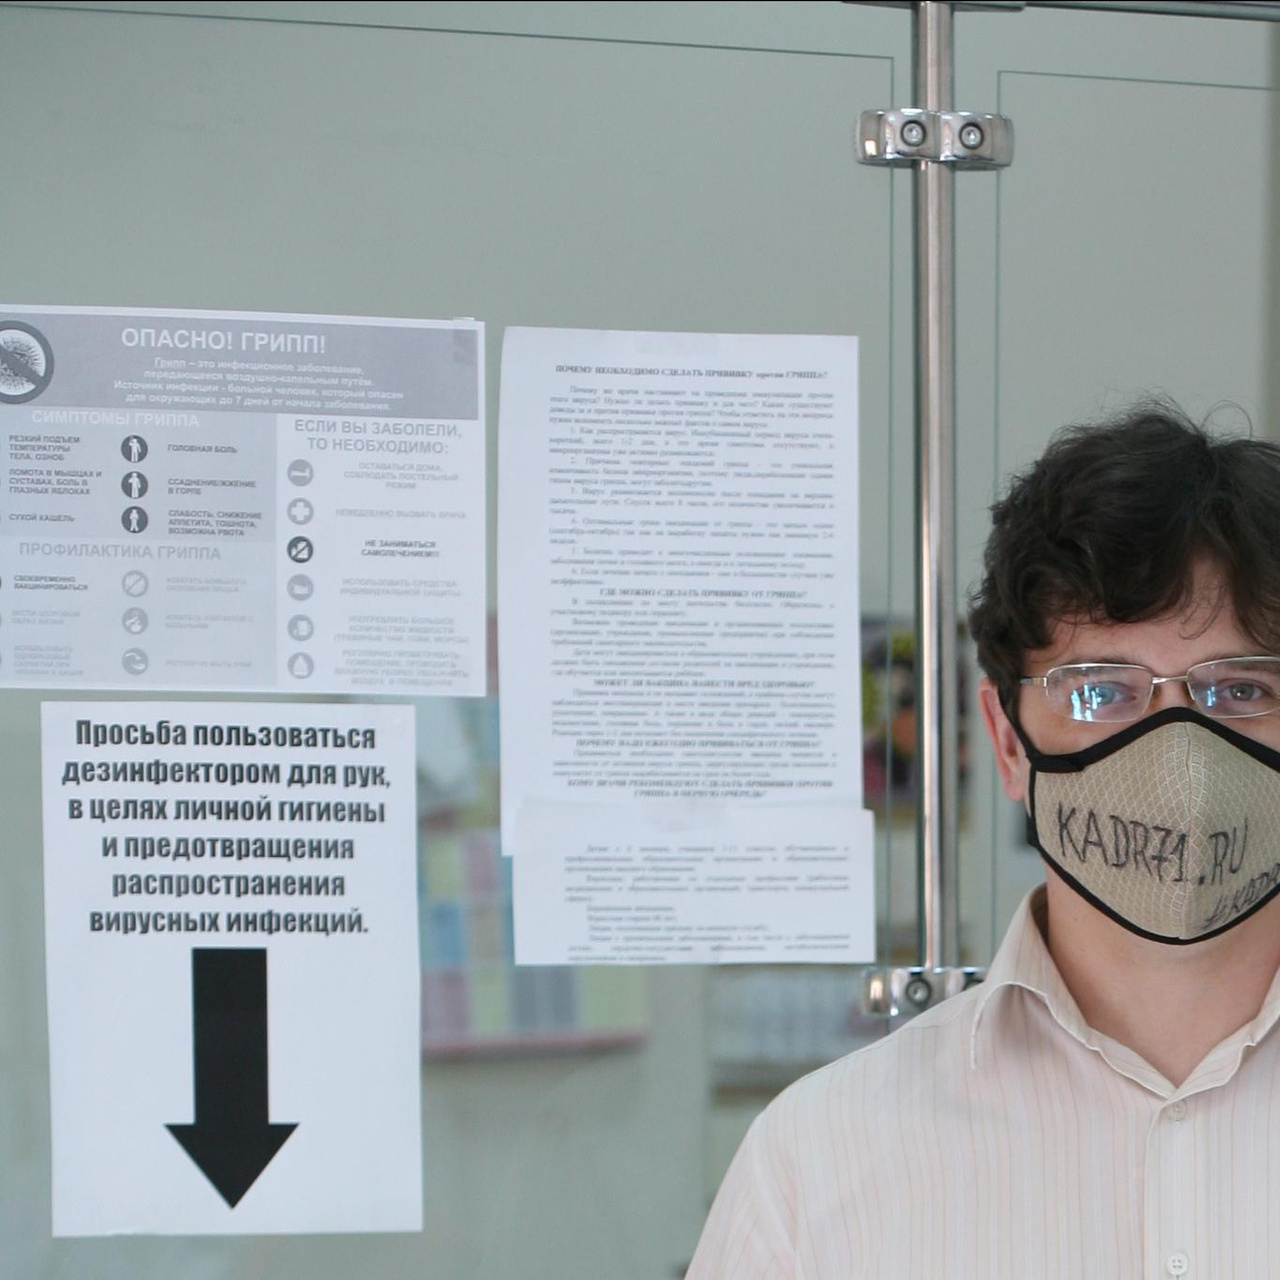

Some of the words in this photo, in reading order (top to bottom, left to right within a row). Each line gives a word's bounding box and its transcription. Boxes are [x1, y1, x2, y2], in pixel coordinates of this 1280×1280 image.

[121, 328, 232, 350] ОПАСНО!
[241, 332, 326, 354] ГРИПП!
[154, 357, 186, 369] Грипп
[114, 380, 163, 391] Источник
[166, 382, 219, 395] инфекции
[32, 409, 129, 426] СИМПТОМЫ
[134, 411, 201, 428] ГРИППА
[295, 419, 338, 433] ЕСЛИ
[342, 420, 367, 434] ВЫ
[372, 422, 463, 438] ЗАБОЛЕЛИ,
[9, 435, 42, 444] РЕЗКИЙ
[308, 436, 328, 450] ТО
[332, 438, 449, 455] НЕОБХОДИМО:
[9, 443, 71, 453] ТЕМПЕРАТУРЫ
[213, 445, 239, 454] БОЛЬ
[35, 453, 65, 462] ОЗНОБ
[9, 468, 44, 477] ЛОМОТА
[56, 477, 80, 487] БОЛЬ
[9, 486, 49, 495] ГЛАЗНЫХ
[9, 512, 36, 522] СУХОЙ
[218, 528, 245, 537] РВОТА
[365, 540, 377, 549] НЕ
[379, 540, 436, 549] ЗАНИМАТЬСЯ
[19, 542, 152, 559] ПРОФИЛАКТИКА
[158, 545, 222, 561] ГРИППА
[14, 574, 75, 583] СВОЕВРЕМЕННО
[14, 582, 88, 592] ВАКЦИНИРОВАТЬСЯ
[76, 720, 187, 746] Просьба
[193, 725, 376, 749] пользоваться
[62, 759, 281, 785] дезинфектором
[287, 765, 337, 786] для
[343, 766, 391, 788] рук,
[69, 801, 82, 820] в
[90, 800, 167, 823] целях
[174, 796, 272, 821] личной
[278, 801, 386, 823] гигиены
[102, 837, 118, 857] и
[124, 837, 354, 862] предотвращения
[112, 874, 345, 898] распространения
[90, 911, 220, 936] вирусных
[226, 907, 369, 937] инфекций.
